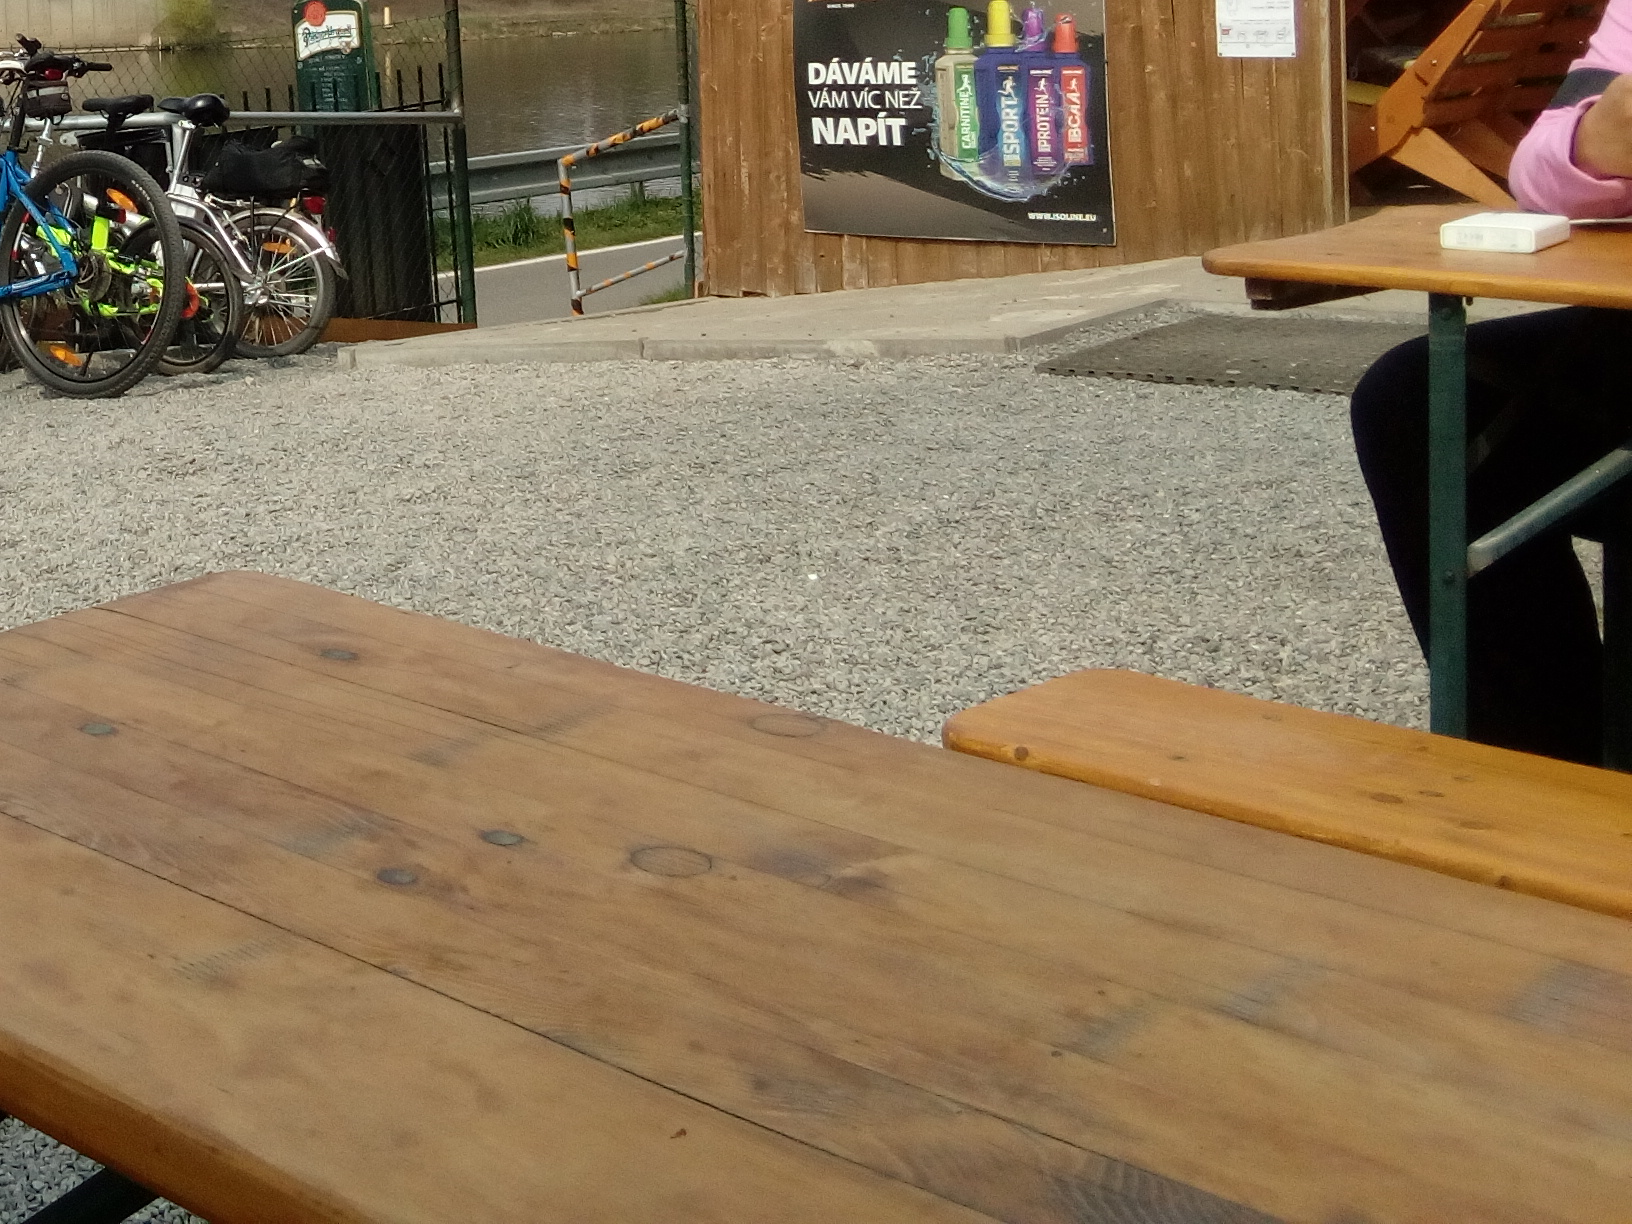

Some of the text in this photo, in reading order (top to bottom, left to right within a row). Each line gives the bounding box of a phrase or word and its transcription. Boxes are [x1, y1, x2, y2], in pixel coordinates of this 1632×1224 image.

[808, 57, 917, 85] DÁVÁME
[808, 86, 923, 109] VÁM VÍC NEŽ
[811, 111, 907, 146] NAPÍT
[1035, 94, 1051, 150] PROTEIN
[1066, 92, 1082, 142] BCAA
